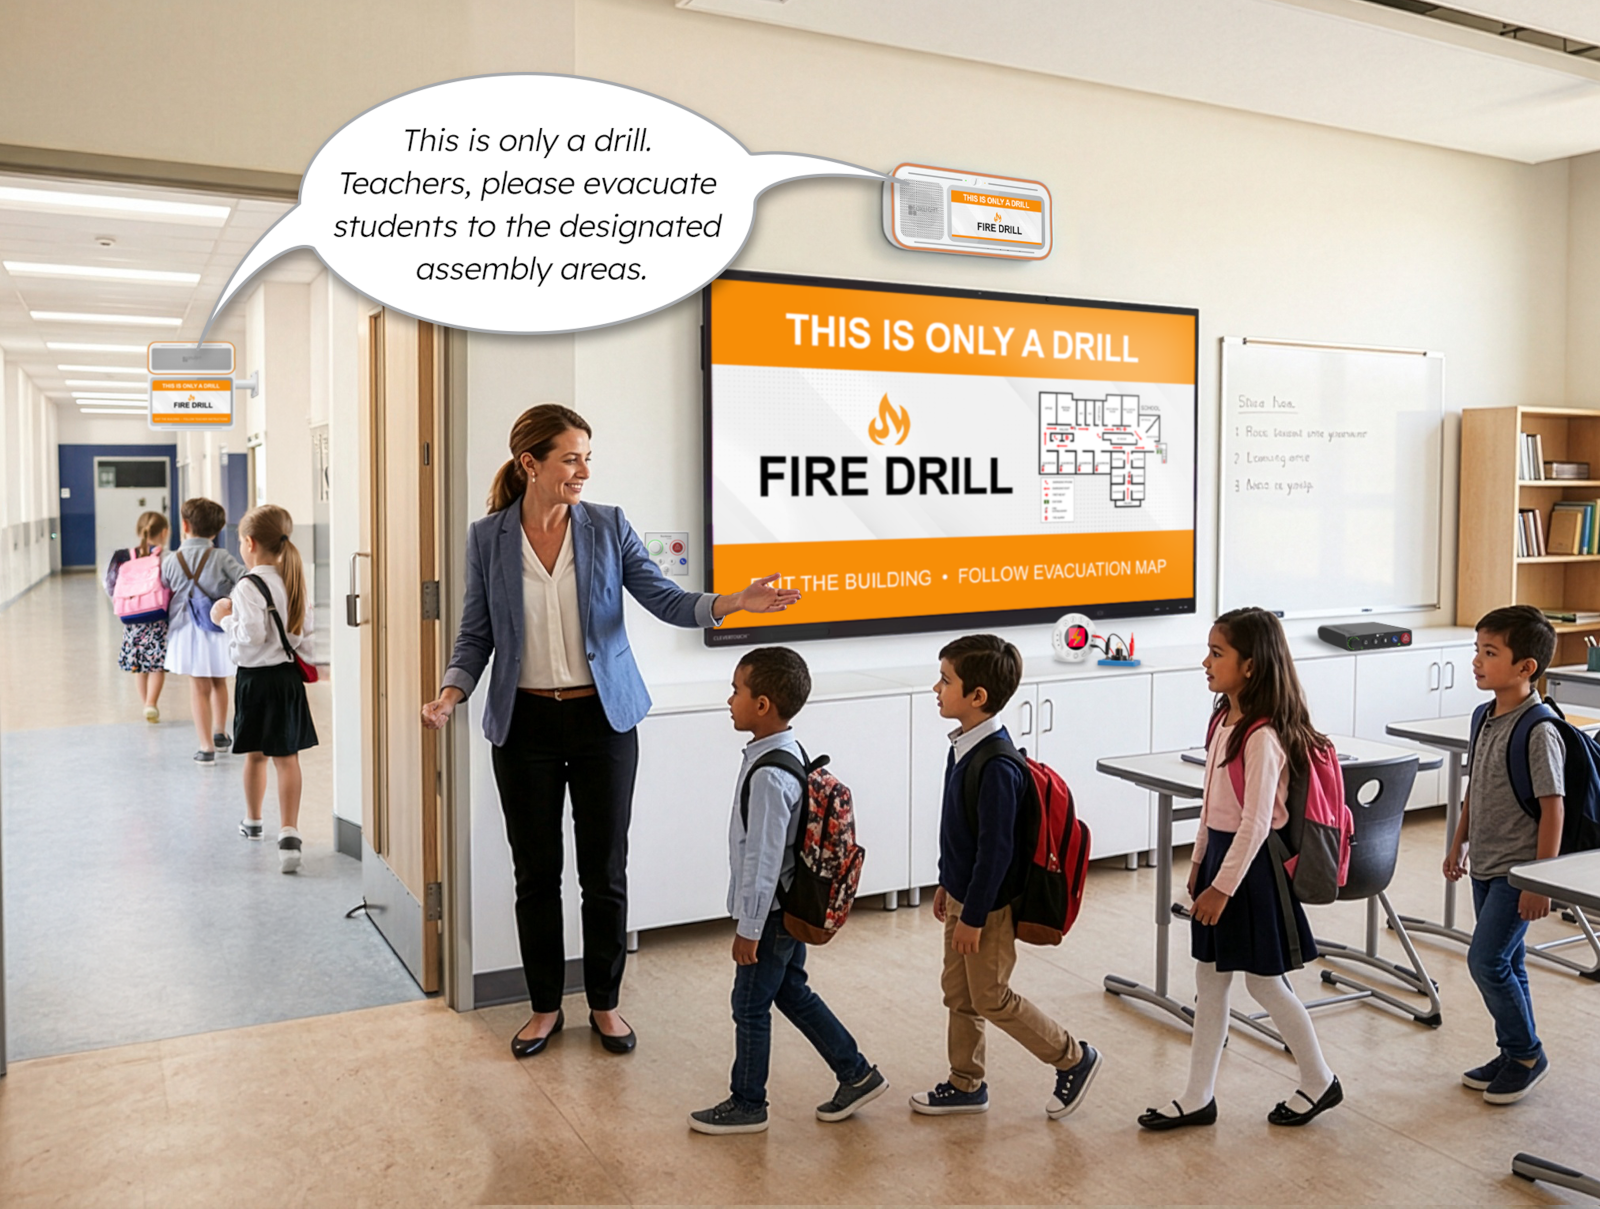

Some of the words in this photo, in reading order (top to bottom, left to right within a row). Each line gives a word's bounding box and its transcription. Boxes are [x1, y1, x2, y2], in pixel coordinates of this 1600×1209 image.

[963, 193, 979, 203] THIS
[987, 196, 1005, 205] ONLY
[1005, 199, 1011, 207] A
[1012, 199, 1030, 208] DRILL
[978, 222, 996, 232] FIRE
[999, 225, 1022, 235] DRILL
[786, 313, 870, 349] THIS
[884, 320, 914, 351] IS
[926, 323, 1014, 356] ONLY
[1022, 329, 1044, 358] A
[1054, 331, 1138, 363] DRILL
[760, 456, 868, 496] FIRE
[886, 457, 1013, 495] DRILL
[801, 574, 838, 591] THE
[846, 570, 931, 589] BUILDING
[959, 566, 1028, 583] FOLLOW
[1034, 561, 1130, 580] EVACUATION
[1136, 559, 1166, 574] MAP
